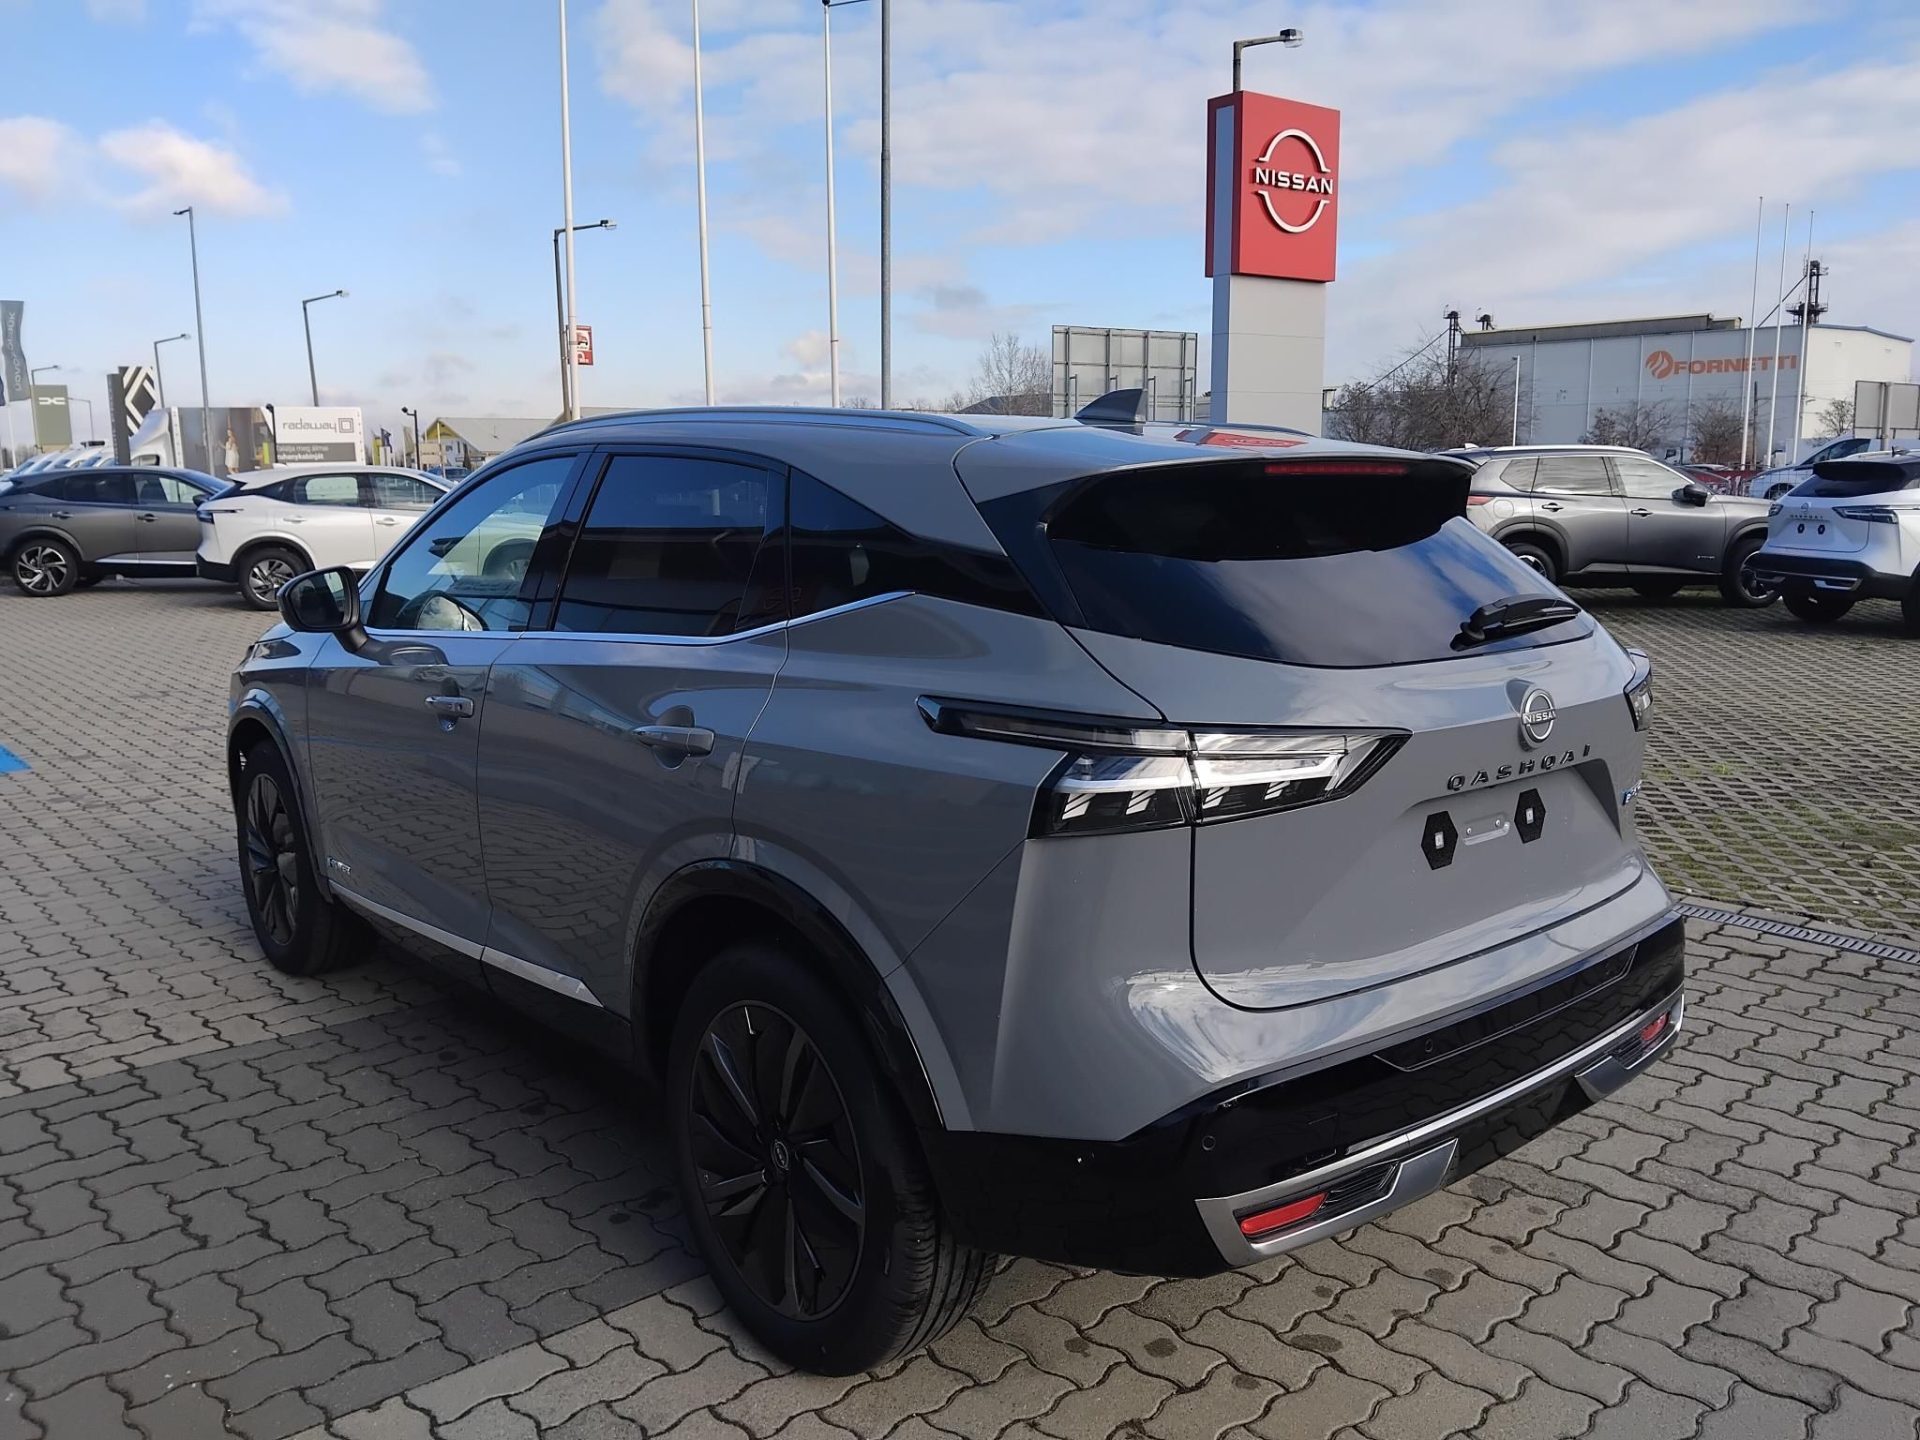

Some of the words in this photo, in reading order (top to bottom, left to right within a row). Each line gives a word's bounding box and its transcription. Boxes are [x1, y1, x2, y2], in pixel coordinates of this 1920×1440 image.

[1255, 167, 1333, 195] NISSAN
[1673, 354, 1797, 375] FORNETTI
[282, 417, 337, 433] radaway
[1447, 744, 1590, 791] QASHQAI
